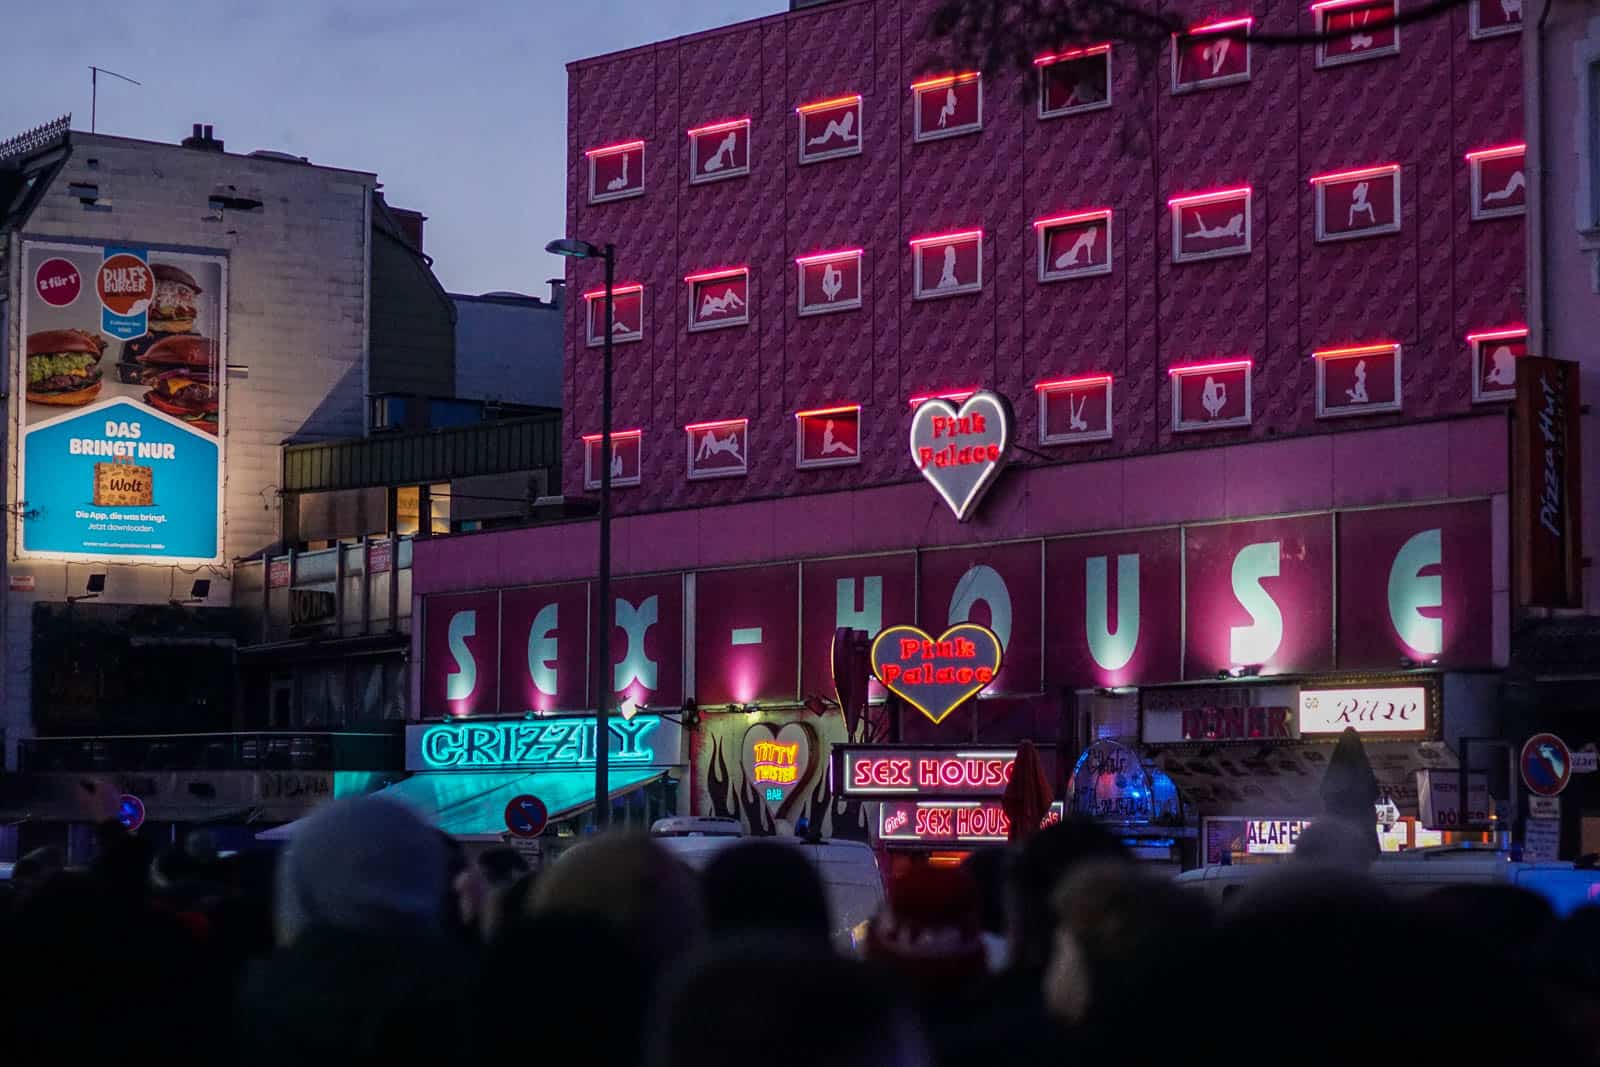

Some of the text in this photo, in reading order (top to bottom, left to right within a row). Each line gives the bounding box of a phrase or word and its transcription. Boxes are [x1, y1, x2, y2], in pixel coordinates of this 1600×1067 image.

[39, 279, 48, 290] 2
[48, 275, 68, 289] für
[103, 280, 147, 293] BURGER
[1537, 373, 1557, 442] Hut
[105, 420, 142, 439] DAS
[931, 411, 987, 439] Pink
[69, 438, 176, 460] BRINGT NUR
[918, 442, 1000, 470] Palace
[109, 478, 143, 493] Wolt
[1539, 447, 1561, 537] Pizza
[75, 511, 89, 519] Die
[110, 511, 122, 520] die
[123, 513, 139, 521] was
[900, 636, 977, 660] Pink
[881, 663, 993, 685] Palace
[422, 718, 661, 766] GRIZZLY
[753, 742, 798, 765] TITTY
[854, 759, 912, 786] SEX
[766, 788, 784, 801] BAR
[884, 808, 1011, 836] Girls SEX HOUS
[1039, 811, 1060, 832] irls
[1247, 821, 1304, 845] ALAFE
